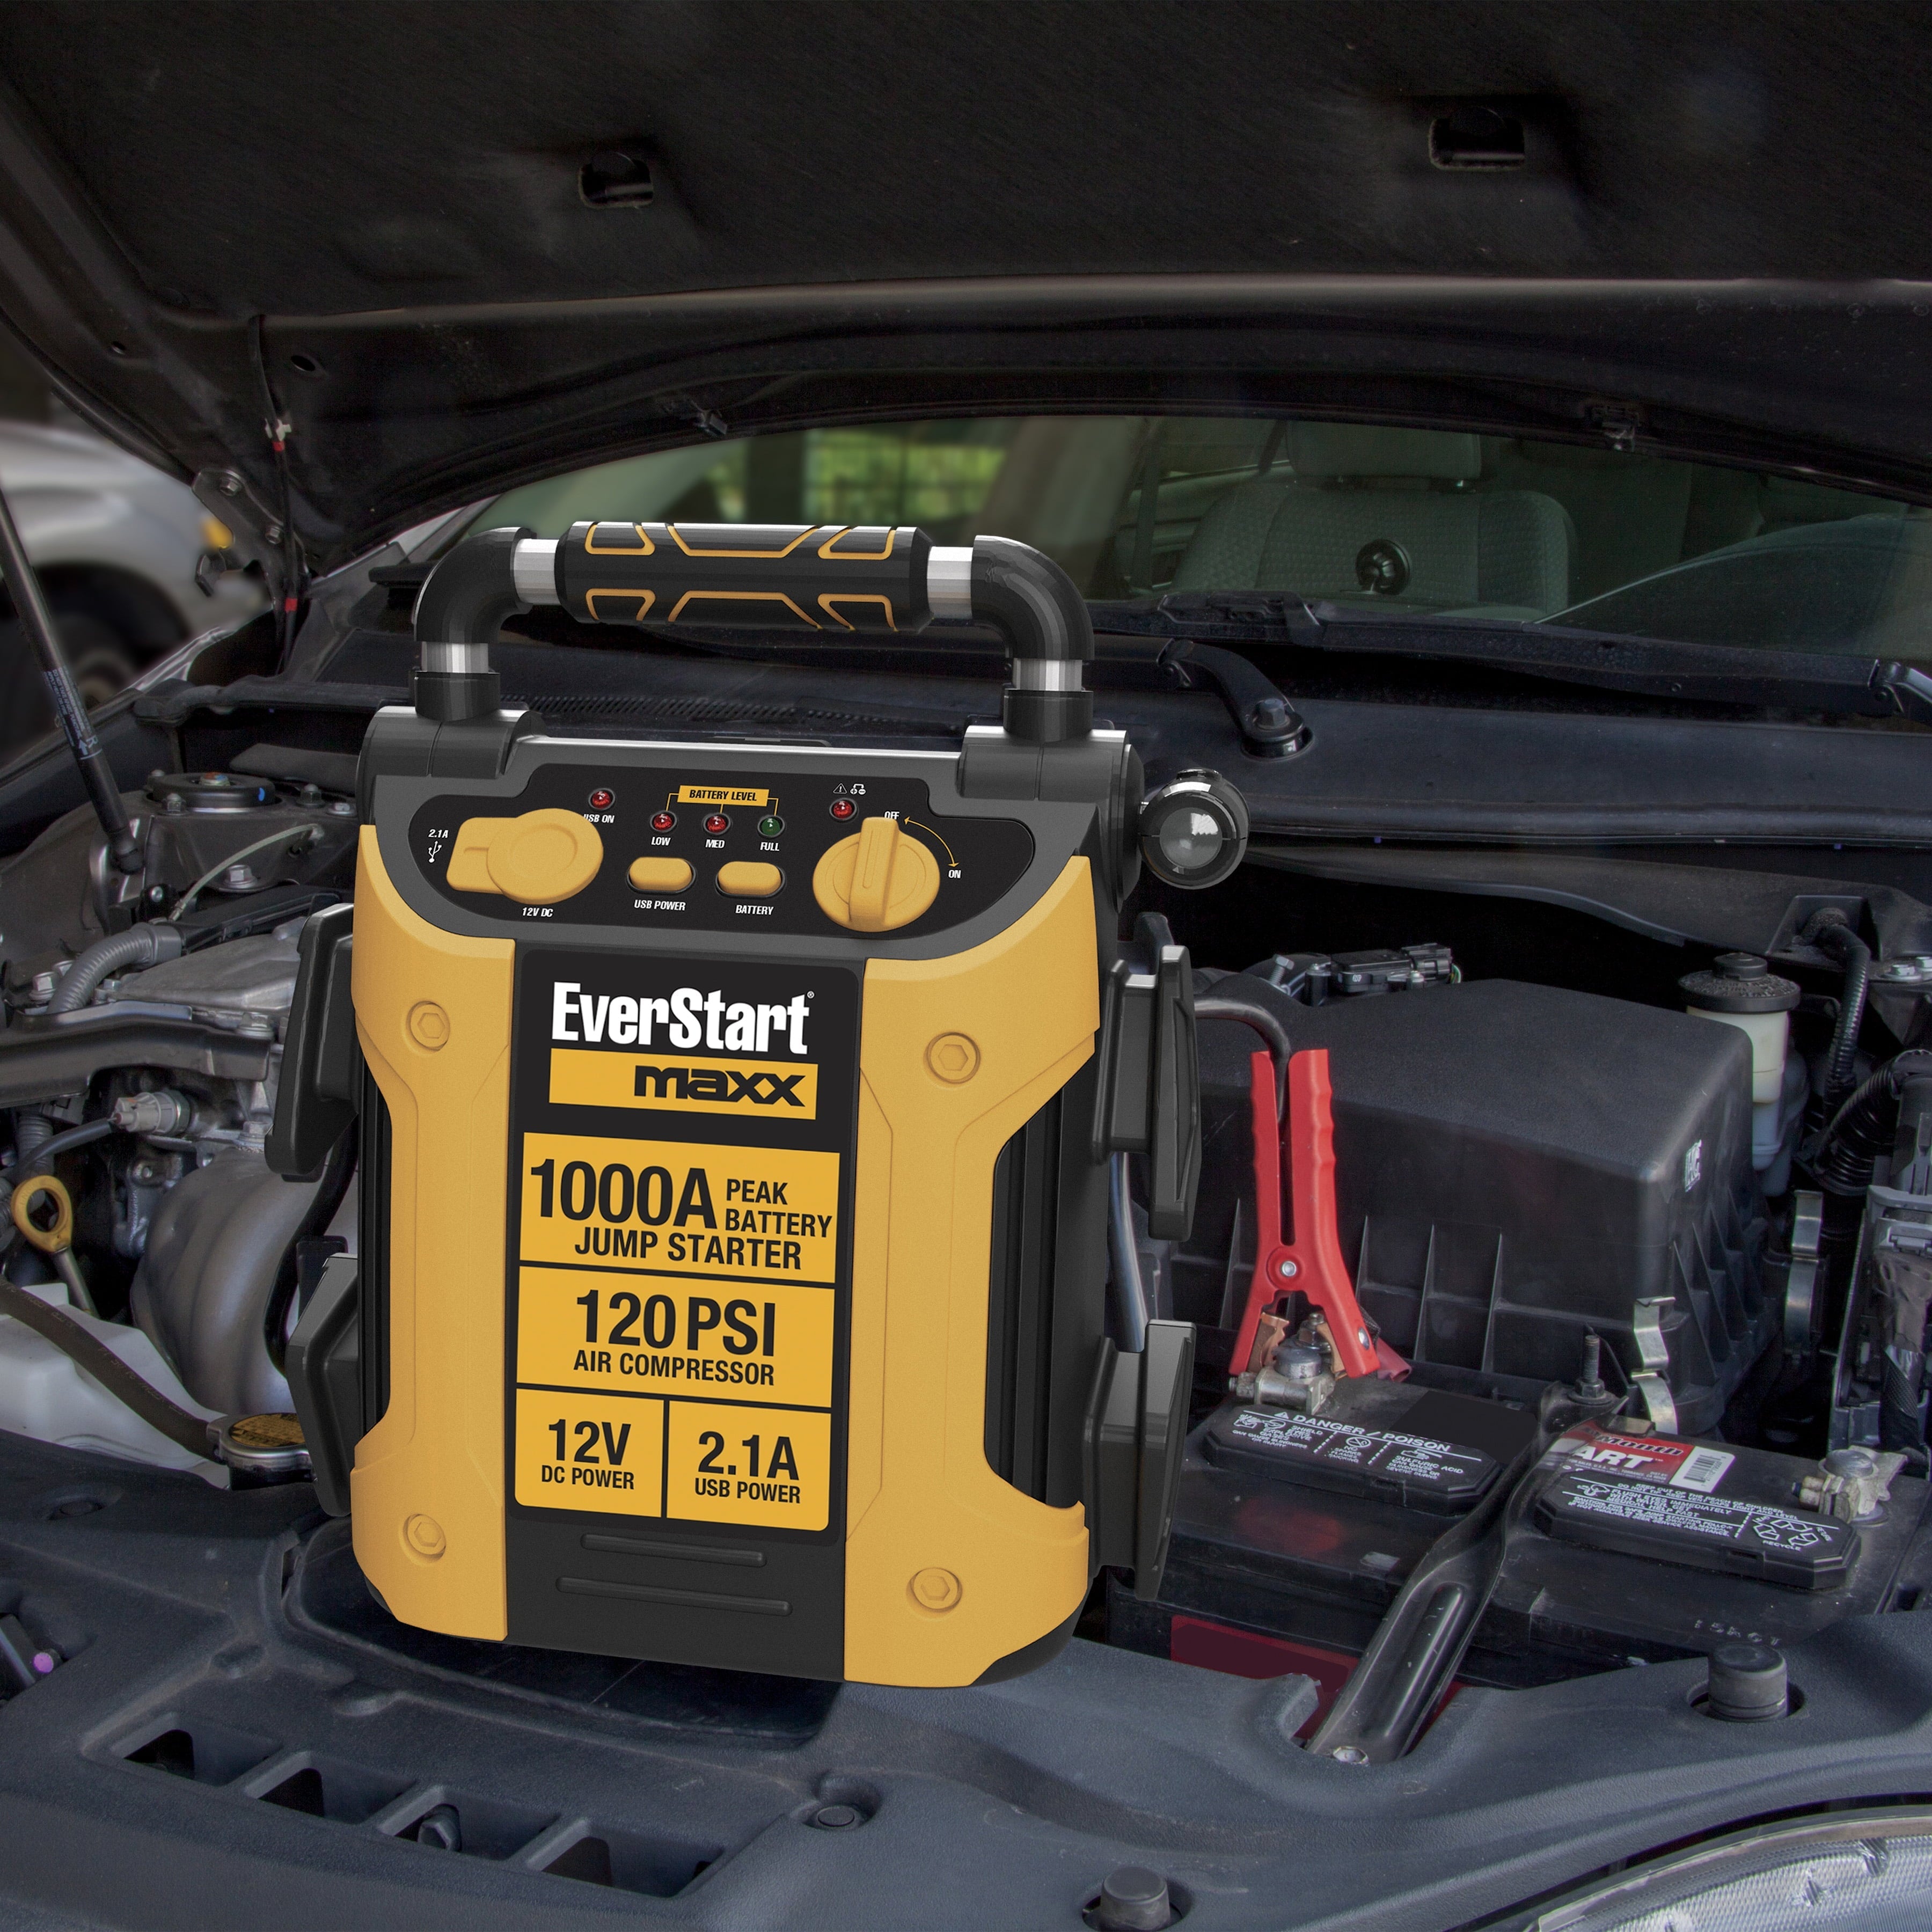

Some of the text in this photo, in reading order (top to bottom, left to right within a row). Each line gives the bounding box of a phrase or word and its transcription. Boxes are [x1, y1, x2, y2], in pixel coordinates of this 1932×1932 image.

[689, 789, 757, 801] BATTERY LEVEL
[602, 815, 614, 823] ON
[884, 811, 899, 820] OFF
[428, 829, 448, 838] 2.1A
[652, 837, 670, 846] LOW
[705, 839, 725, 848] MED
[760, 842, 780, 851] FULL
[948, 869, 961, 879] ON
[634, 900, 686, 911] USB POWER
[736, 905, 773, 915] BATTERY
[522, 907, 553, 917] 12V DC
[552, 982, 809, 1054] EverStart
[634, 1065, 806, 1107] maxx
[531, 1159, 717, 1230] 1000A
[726, 1179, 788, 1205] PEAK
[726, 1209, 832, 1238] BATTERY
[575, 1226, 801, 1270] JUMP STARTER
[577, 1289, 775, 1357] 120 PSI
[574, 1350, 774, 1386] AIR COMPRESSOR
[1291, 1425, 1323, 1435] SHIELD
[1293, 1415, 1365, 1435] DANGER
[1382, 1433, 1451, 1452] POISON
[548, 1419, 631, 1465] 12V
[698, 1431, 799, 1481] 2.1A
[1394, 1456, 1439, 1468] SULFURIC
[541, 1465, 634, 1489] DC POWER
[694, 1478, 800, 1504] USB POWER
[1606, 1497, 1645, 1507] MEDICAL
[1612, 1489, 1641, 1497] FLUSH
[1670, 1500, 1731, 1514] IMMEDIATELY
[1762, 1540, 1801, 1550] RECYCLE
